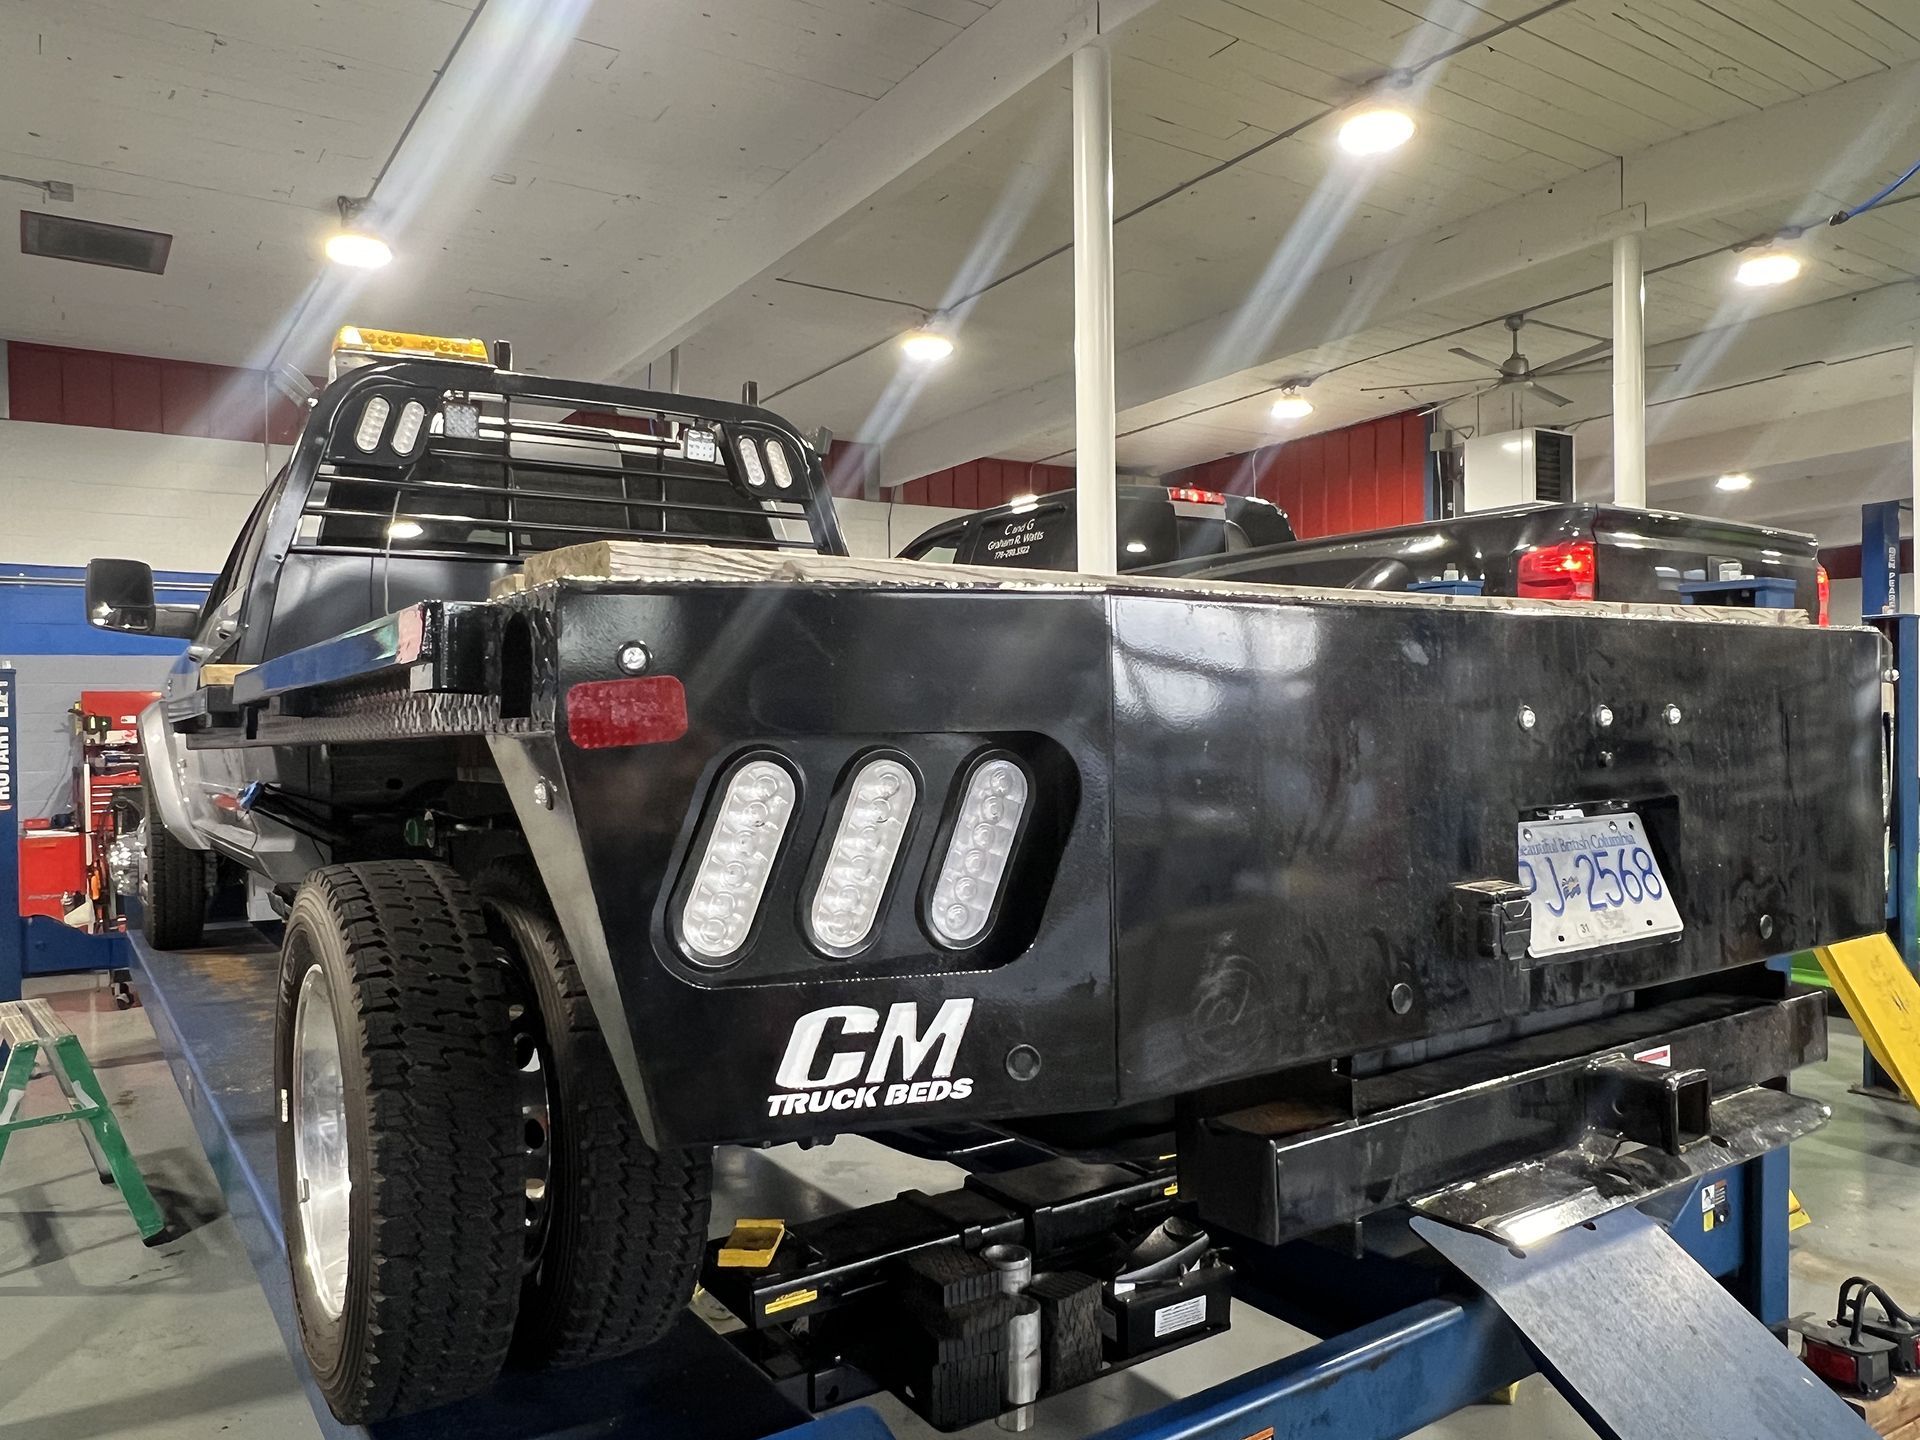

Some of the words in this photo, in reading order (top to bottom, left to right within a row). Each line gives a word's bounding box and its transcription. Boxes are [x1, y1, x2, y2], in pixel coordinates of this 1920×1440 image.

[1004, 523, 1013, 535] C
[1026, 518, 1035, 530] G
[1520, 838, 1559, 855] eautiful
[1590, 831, 1637, 851] Columbia
[1575, 847, 1662, 911] 2568
[775, 998, 974, 1089] CM
[767, 1085, 880, 1117] TRUCK
[883, 1077, 974, 1106] BEDS
